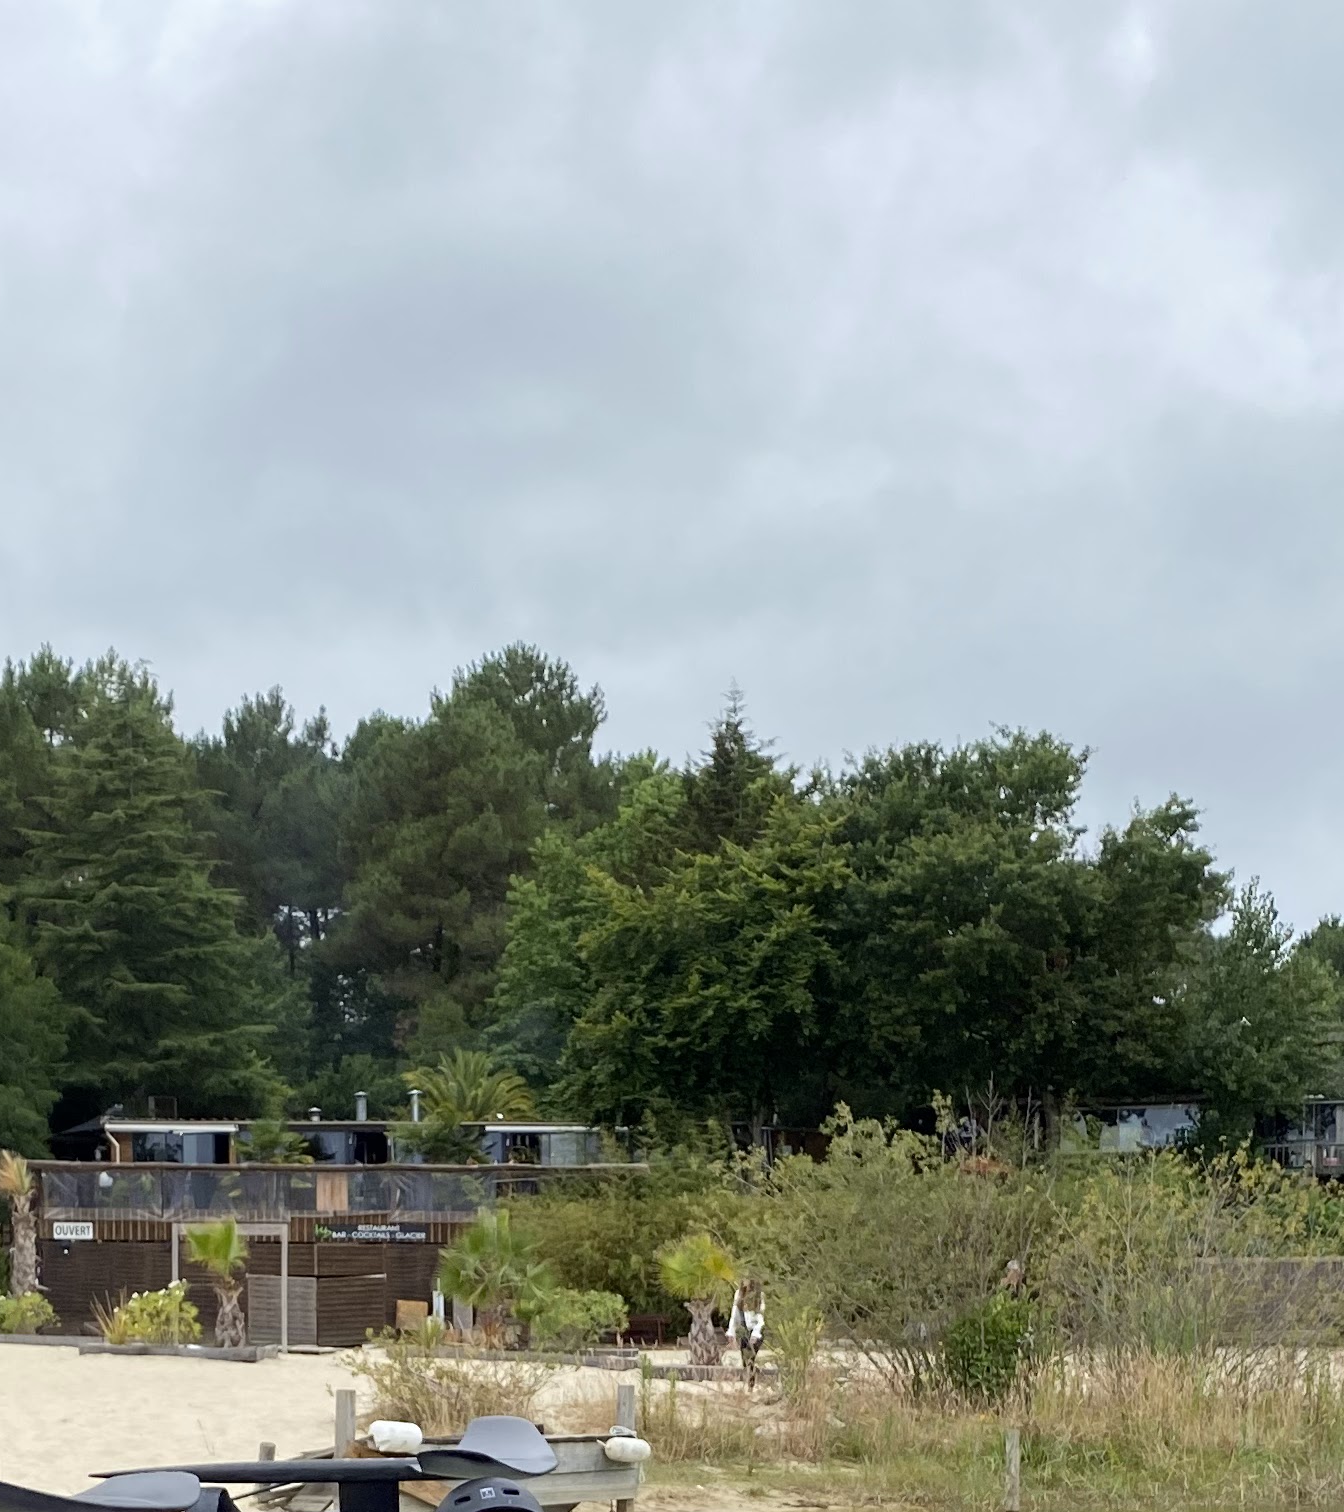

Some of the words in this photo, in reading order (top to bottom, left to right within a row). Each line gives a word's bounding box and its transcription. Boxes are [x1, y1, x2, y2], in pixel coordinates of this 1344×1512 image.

[55, 1225, 91, 1236] OUVERT
[332, 1231, 346, 1239] BAR
[351, 1231, 391, 1239] COCKTAILS
[396, 1231, 426, 1239] GLACIER
